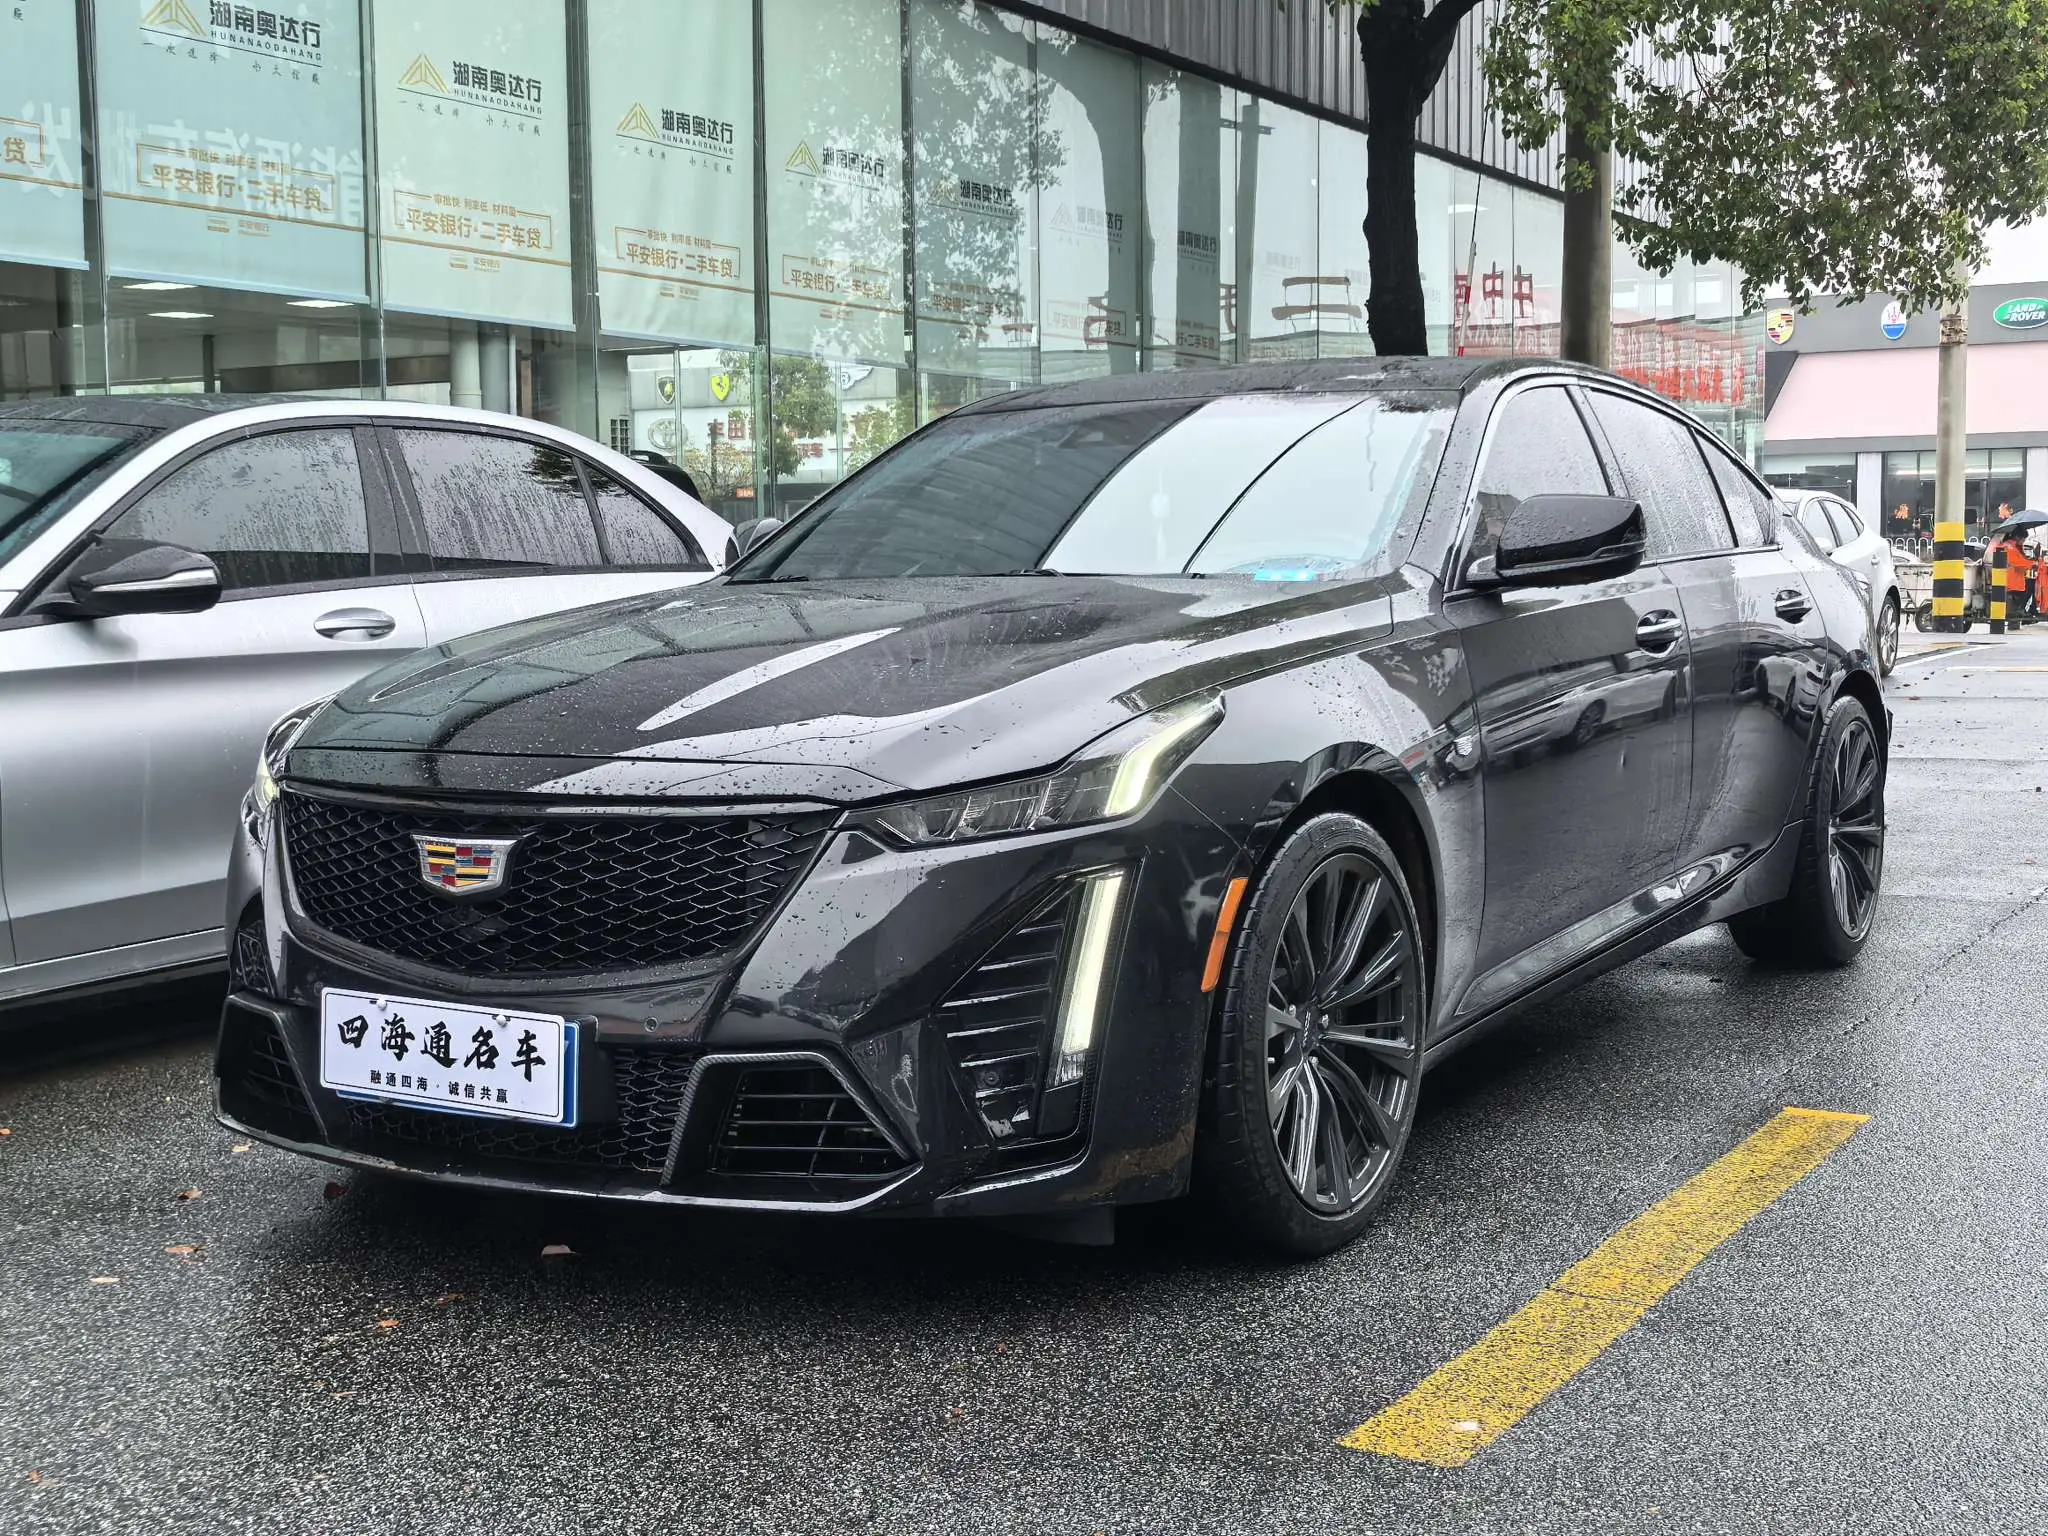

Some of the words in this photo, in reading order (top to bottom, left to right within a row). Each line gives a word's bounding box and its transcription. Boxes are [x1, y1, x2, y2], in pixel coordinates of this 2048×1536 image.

[209, 0, 321, 49] 湖南奥达行
[453, 60, 542, 103] 湖南奥达行
[661, 107, 733, 144] 湖南奥达行
[153, 163, 323, 212] 平安银行·二手车贷
[407, 207, 542, 250] 平安银行·二手车贷
[626, 242, 733, 280] 平安银行·二手车贷
[2007, 303, 2038, 314] LAND
[2009, 310, 2046, 322] ROVER
[337, 1012, 547, 1083] 四海通名车
